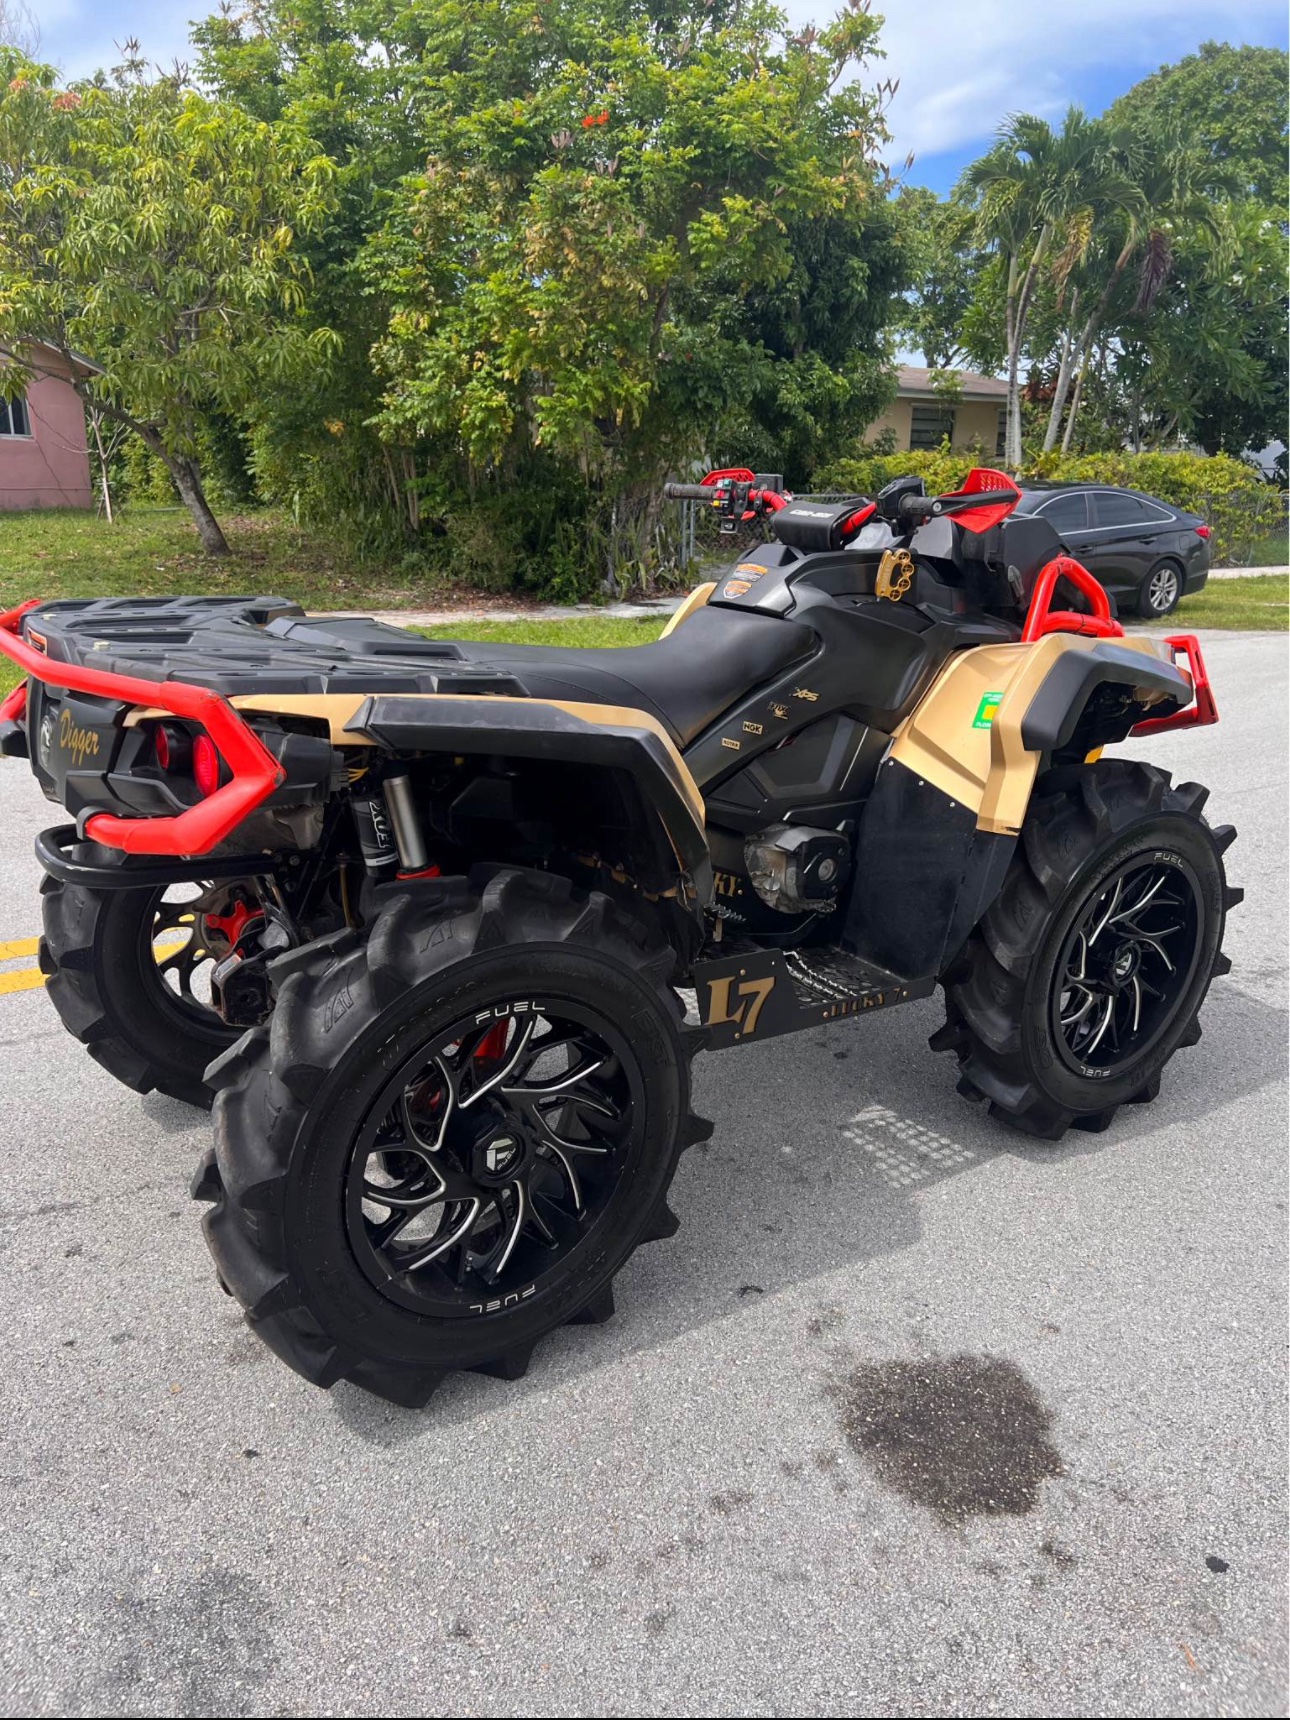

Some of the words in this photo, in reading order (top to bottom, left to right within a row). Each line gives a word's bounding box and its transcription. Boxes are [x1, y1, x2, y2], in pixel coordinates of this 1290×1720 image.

[61, 708, 99, 766] Digger
[743, 722, 762, 734] NGK
[369, 801, 391, 849] FOX
[1153, 852, 1184, 869] FUEL
[475, 1000, 546, 1025] FUEL
[704, 975, 775, 1034] L7
[1080, 1065, 1111, 1078] FUEL
[469, 1284, 536, 1314] FUEL
